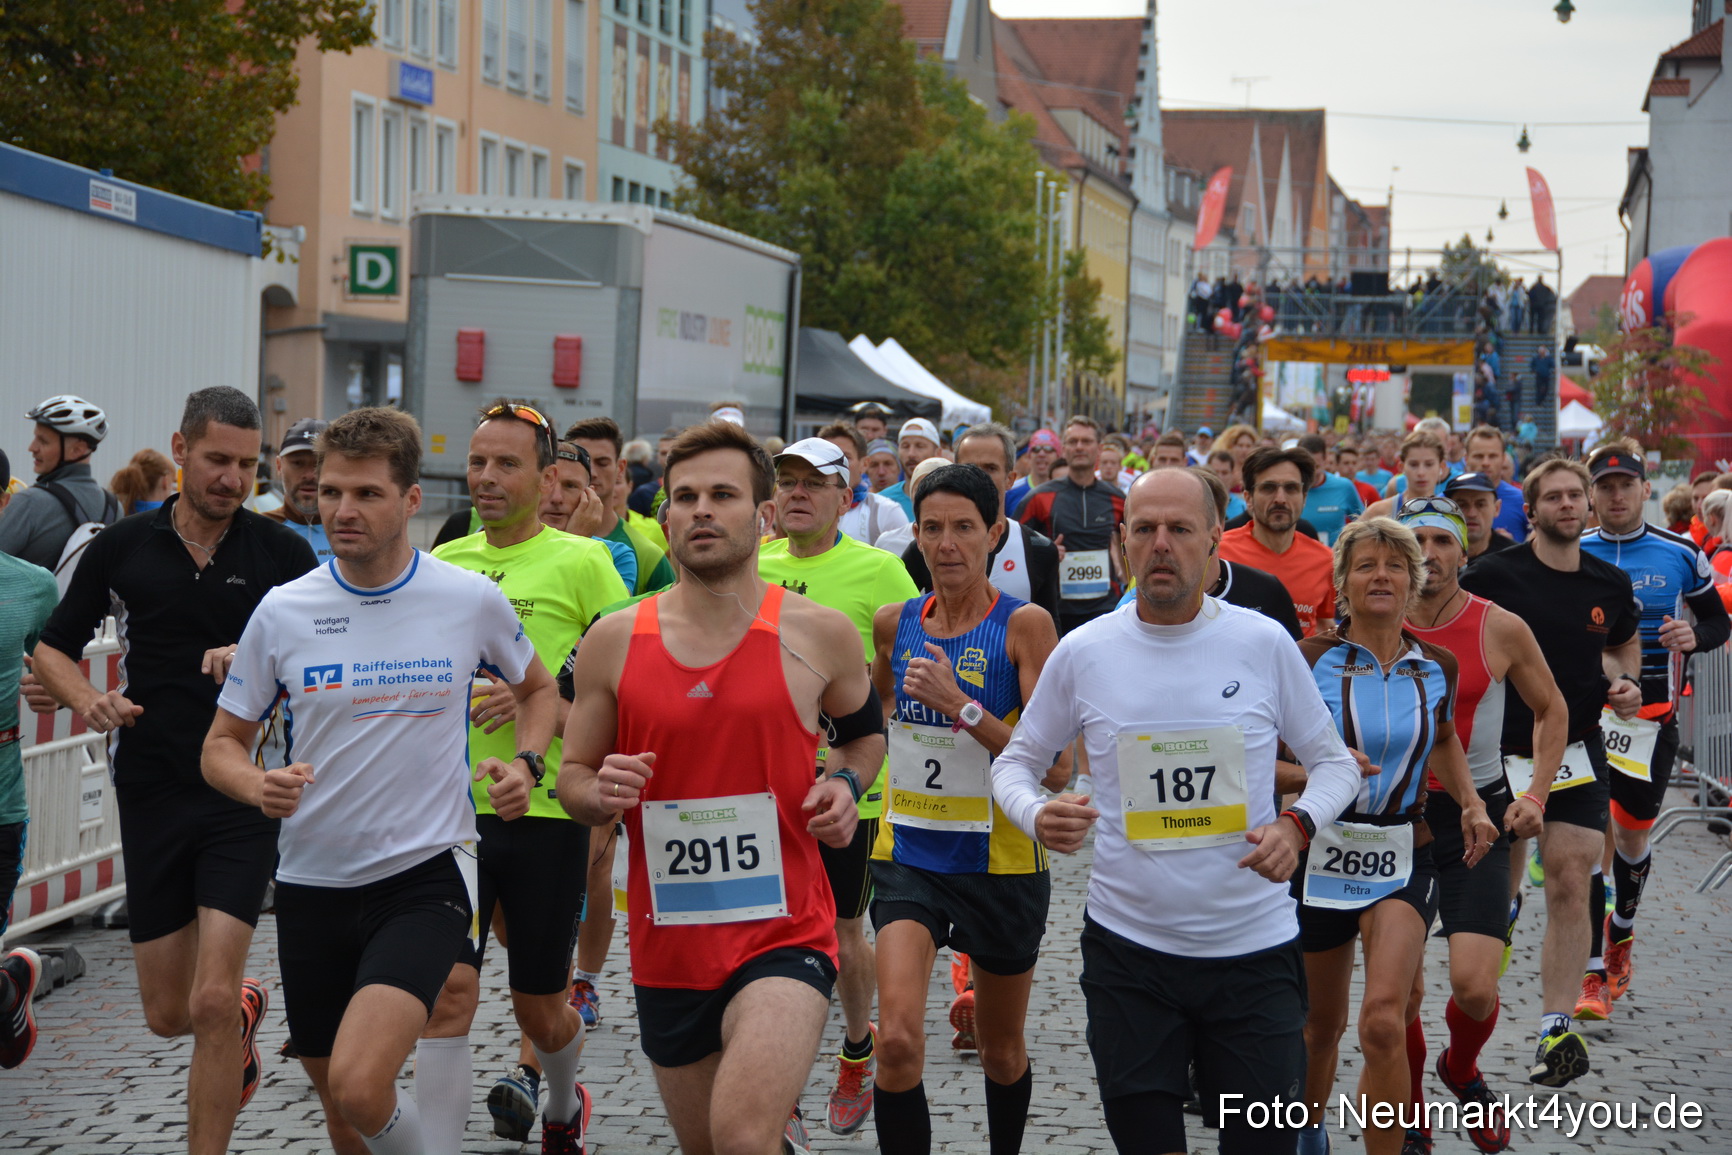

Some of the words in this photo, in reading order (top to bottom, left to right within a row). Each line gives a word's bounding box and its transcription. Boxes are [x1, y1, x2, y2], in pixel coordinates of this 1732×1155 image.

[356, 251, 393, 289] D
[1067, 565, 1102, 580] 2999
[313, 616, 350, 626] Wolfgang
[315, 626, 348, 635] Hofbeck
[353, 658, 453, 673] Raiffeisenbank
[352, 676, 373, 687] am
[378, 674, 433, 685] Rothsee
[437, 672, 453, 682] eG
[352, 692, 400, 705] kompetent
[409, 689, 429, 700] fair
[920, 735, 955, 748] BOCK
[1164, 740, 1208, 752] BOCK
[924, 758, 943, 790] 2
[1149, 765, 1216, 803] 187
[894, 793, 948, 813] Christine
[691, 808, 737, 821] BOCK
[1161, 815, 1212, 829] Thomas
[1353, 832, 1387, 840] BOCK
[665, 833, 760, 875] 2915
[1323, 846, 1396, 878] 2698
[656, 871, 661, 879] D
[1343, 883, 1371, 895] Petra
